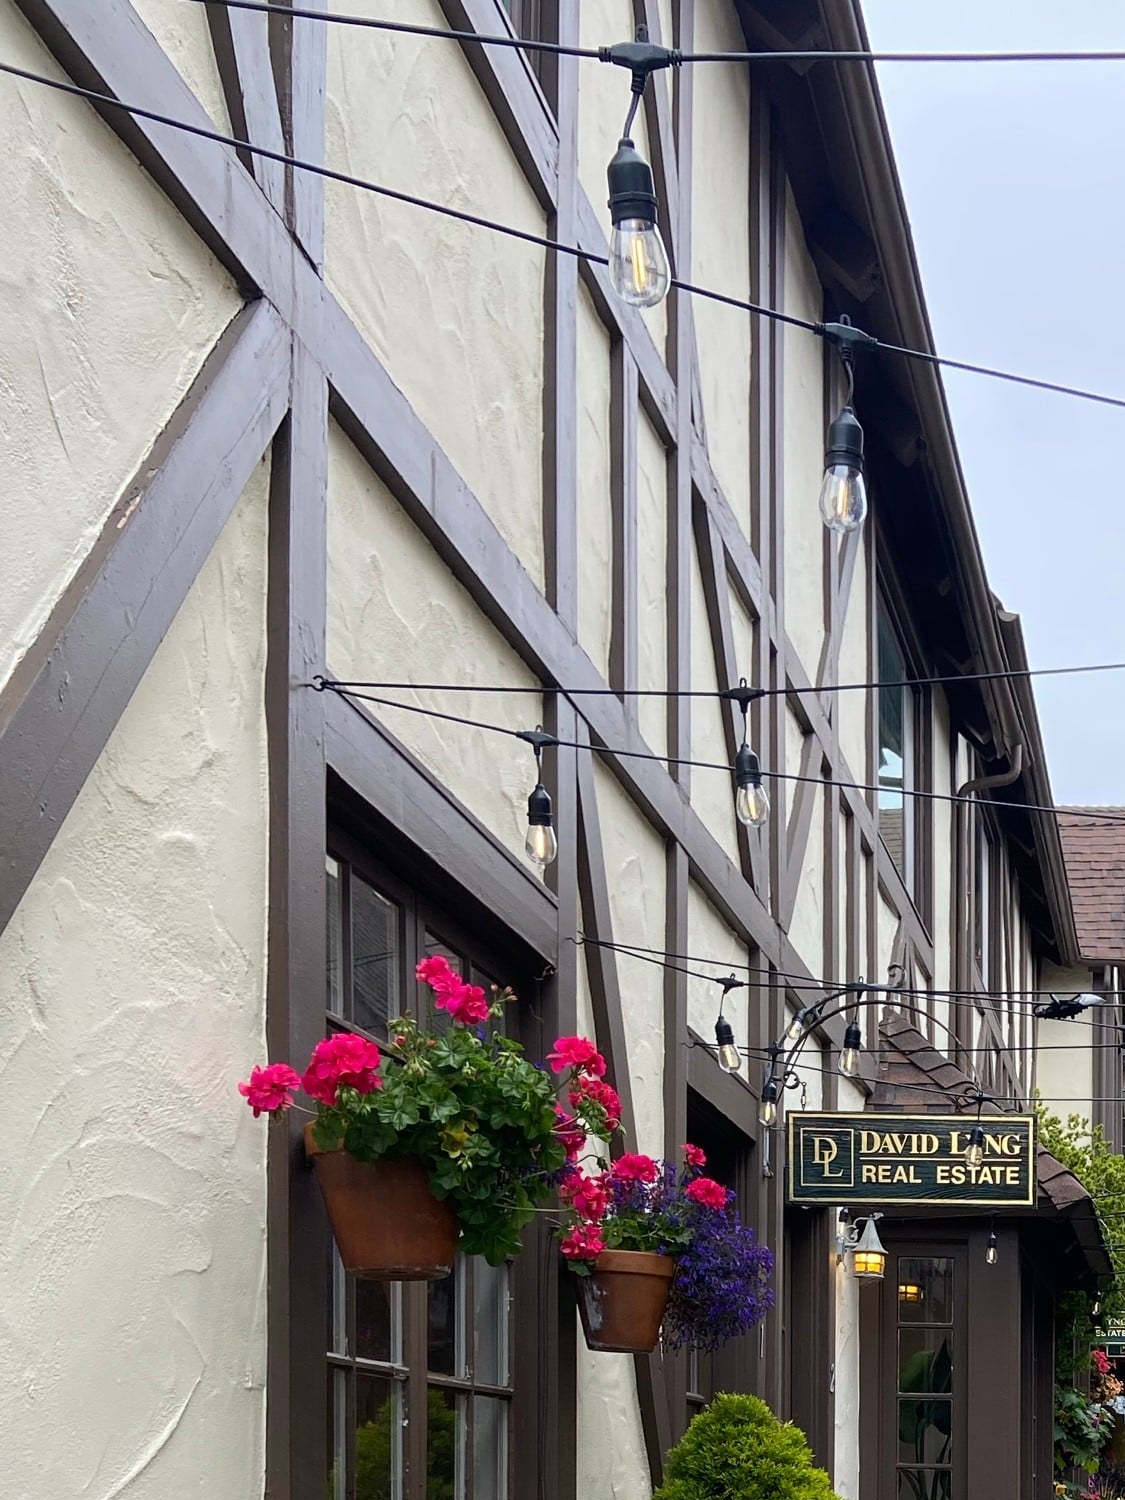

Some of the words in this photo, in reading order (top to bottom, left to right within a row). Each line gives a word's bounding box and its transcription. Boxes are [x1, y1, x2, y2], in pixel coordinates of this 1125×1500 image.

[859, 1130, 940, 1155] DAVID
[948, 1131, 1022, 1156] LNG
[861, 1164, 922, 1184] REAL
[936, 1165, 1020, 1185] ESTATE
